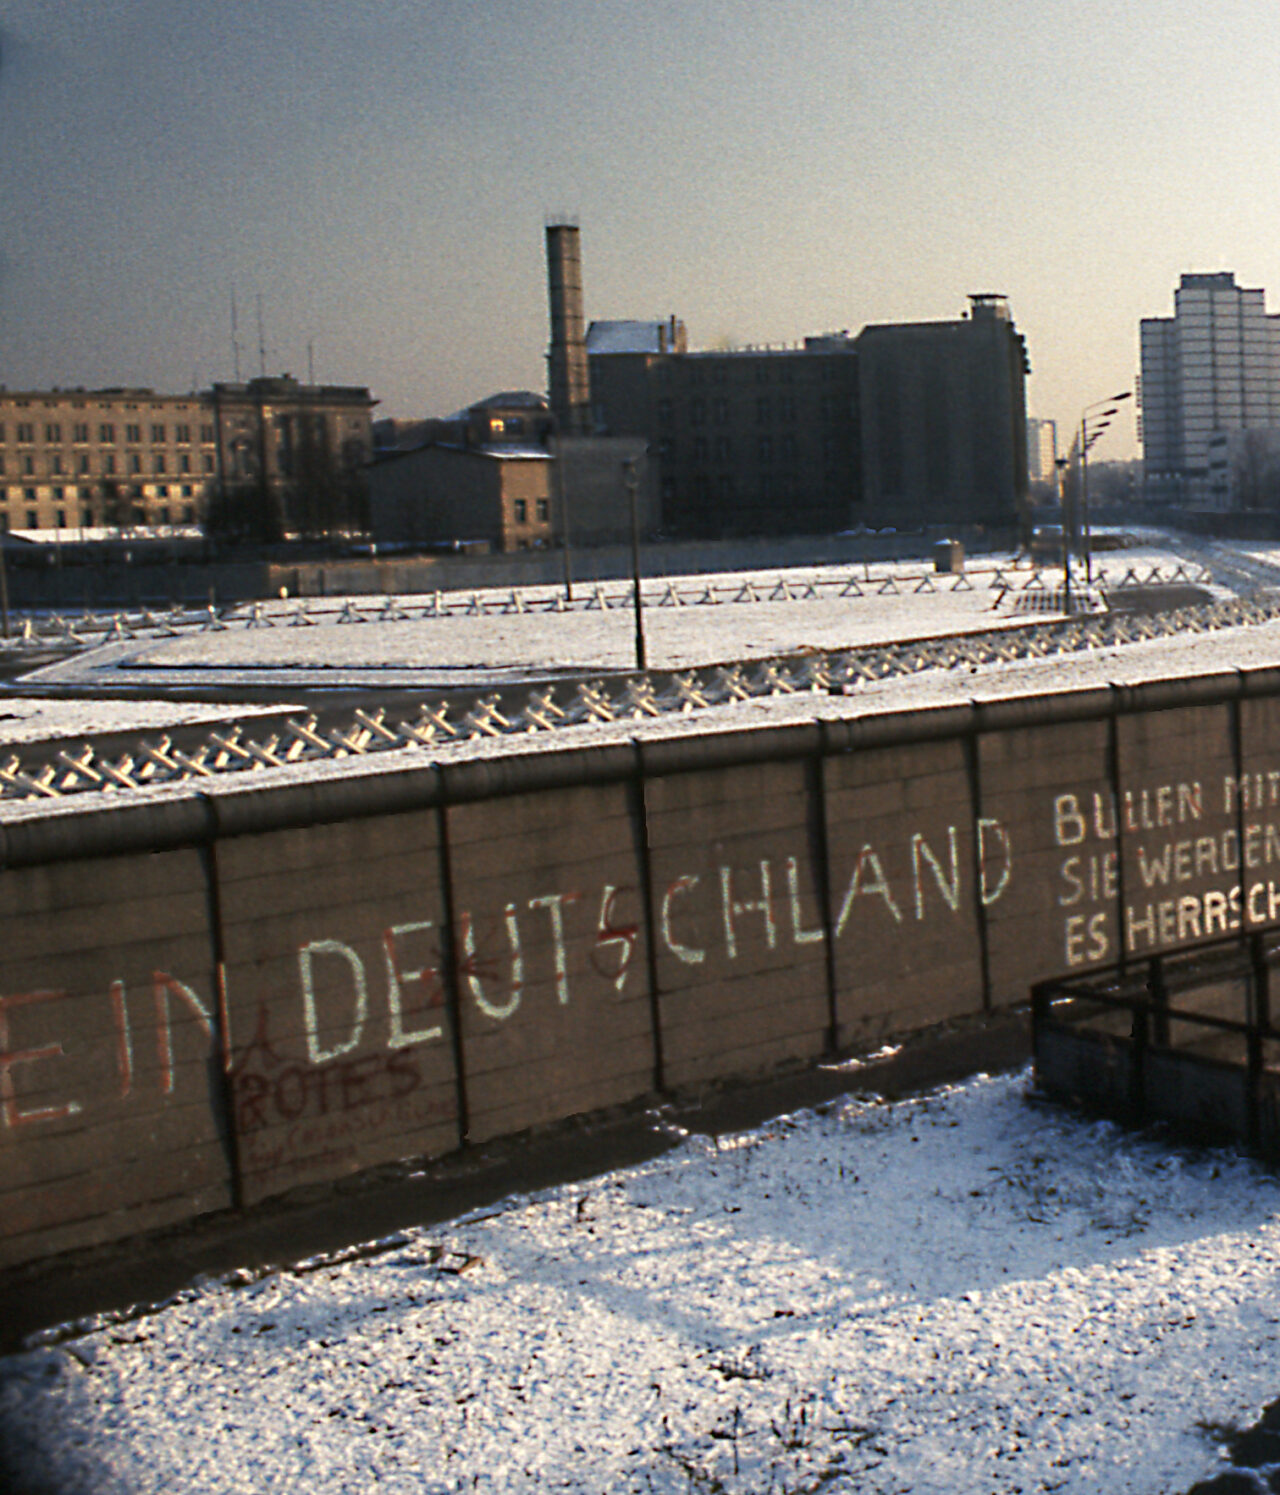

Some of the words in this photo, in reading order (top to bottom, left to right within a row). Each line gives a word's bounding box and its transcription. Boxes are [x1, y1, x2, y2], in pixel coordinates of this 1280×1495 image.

[1054, 781, 1202, 846] BULLEN
[1059, 852, 1118, 906] SIE
[1064, 912, 1108, 967] ES
[0, 961, 235, 1127] EIN
[299, 817, 1012, 1065] DEUTSCHLAND
